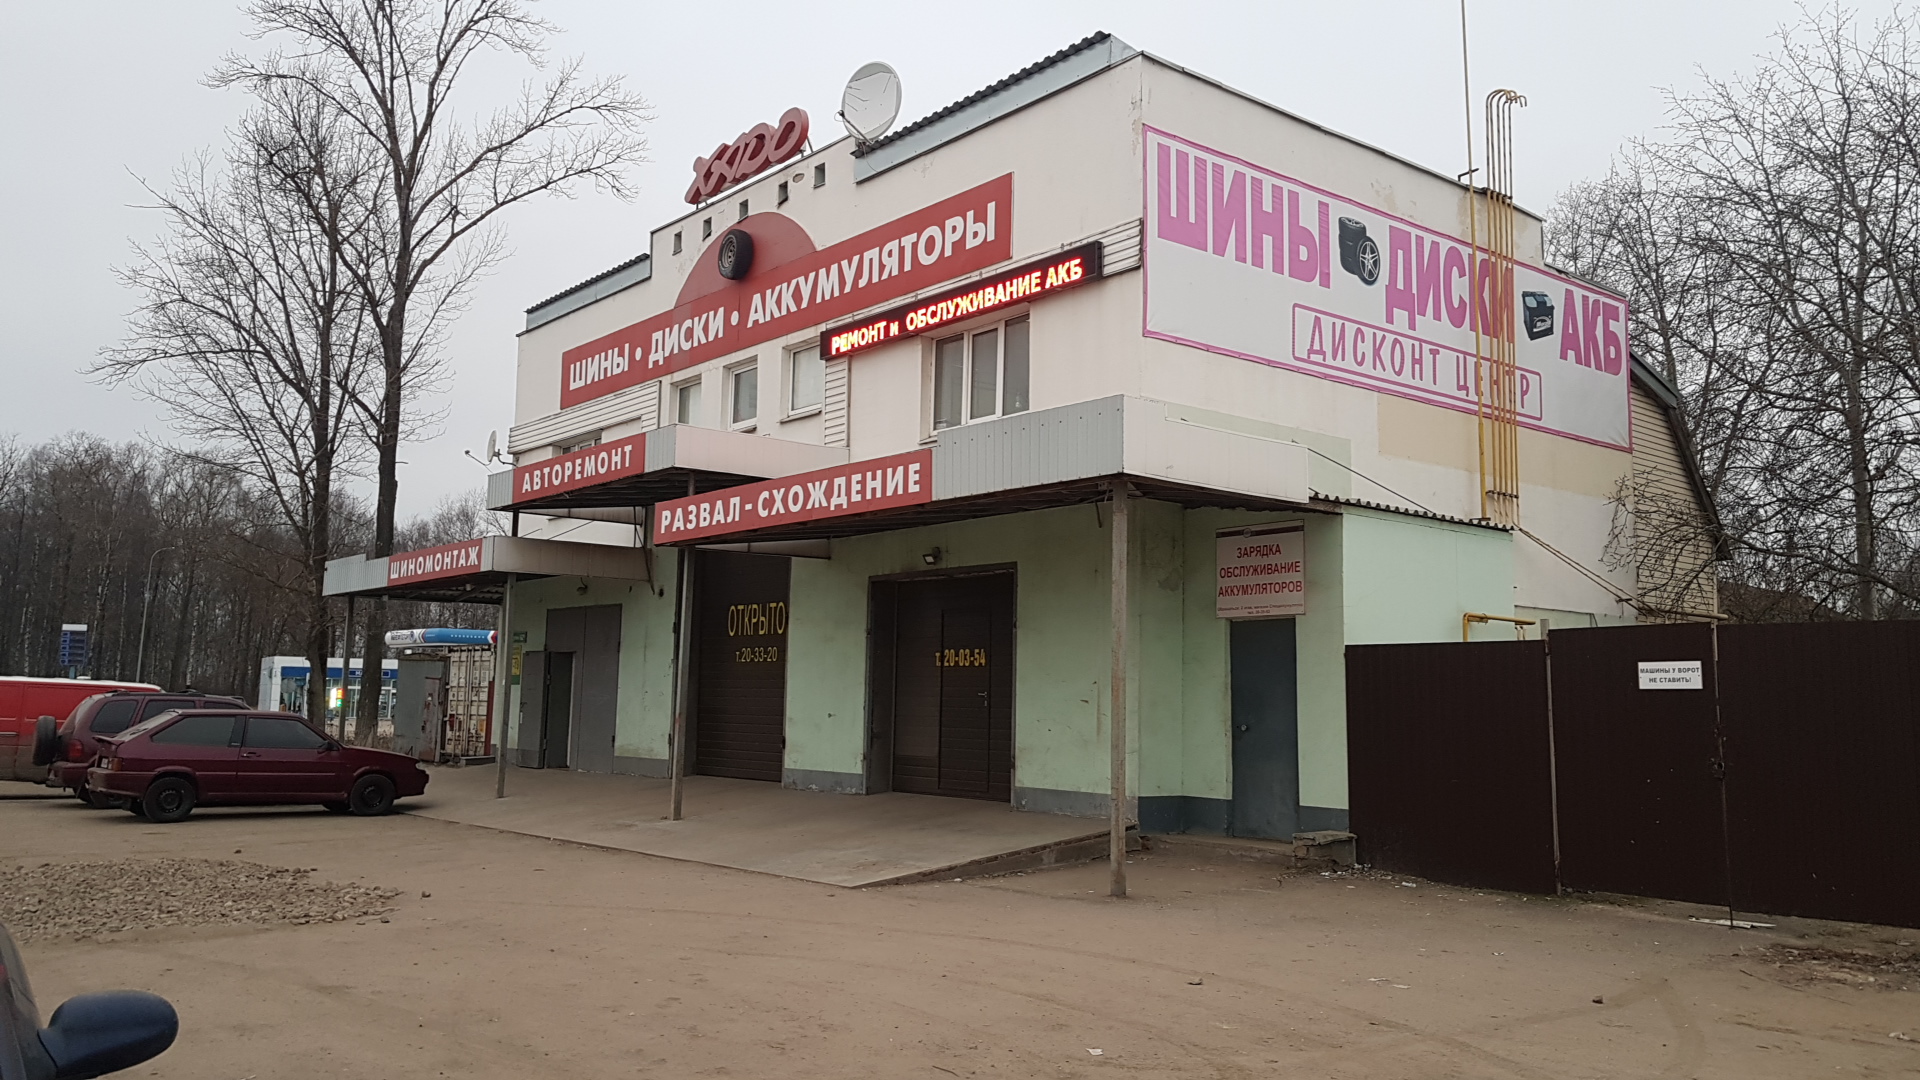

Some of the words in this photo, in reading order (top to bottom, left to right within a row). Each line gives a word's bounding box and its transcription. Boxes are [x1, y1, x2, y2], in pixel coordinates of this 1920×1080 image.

[1157, 141, 1331, 290] ШИНЫ
[1385, 224, 1515, 344] ДИСКИ
[1559, 287, 1624, 377] АКБ
[569, 343, 629, 391] ШИНЫ
[648, 306, 725, 369] ДИСКИ
[747, 200, 996, 328] АККУМУЛЯТОРЫ
[831, 320, 888, 356] РЕМОНТ
[905, 271, 1042, 331] ОБСЛУЖИВАНИЕ
[1044, 258, 1083, 289] АКБ
[1307, 314, 1441, 386] ДИСКОНТ
[521, 444, 633, 494] АВТОРЕМОНТ
[390, 545, 479, 580] ШИНОМОНТАЖ
[1236, 543, 1282, 559] ЗАРЯДКА
[1219, 560, 1301, 579] ОБСЛУЖИВАНИЕ
[1217, 580, 1303, 598] АККУМУЛЯТОРОВ
[728, 601, 786, 637] ОТКРЫТО
[943, 648, 986, 667] 20-03-54
